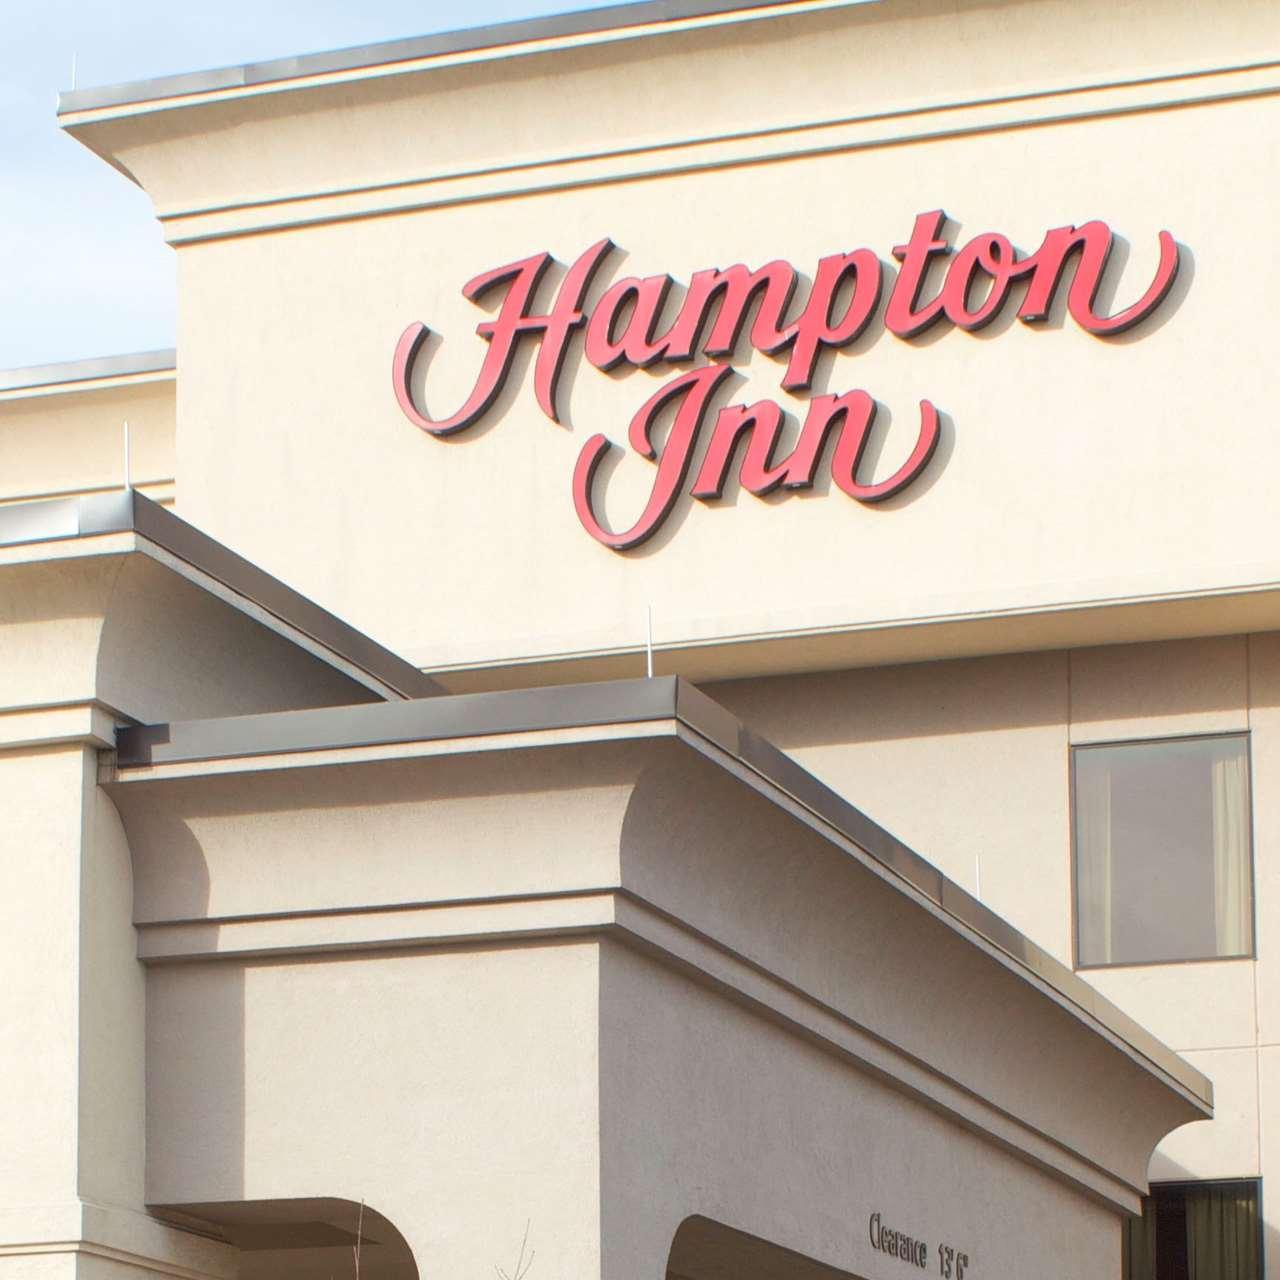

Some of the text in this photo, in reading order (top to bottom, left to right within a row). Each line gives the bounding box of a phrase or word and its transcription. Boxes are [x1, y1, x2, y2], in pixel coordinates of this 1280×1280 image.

[392, 209, 1179, 437] Hampton
[572, 363, 941, 551] Inn
[869, 1212, 928, 1270] Clearance
